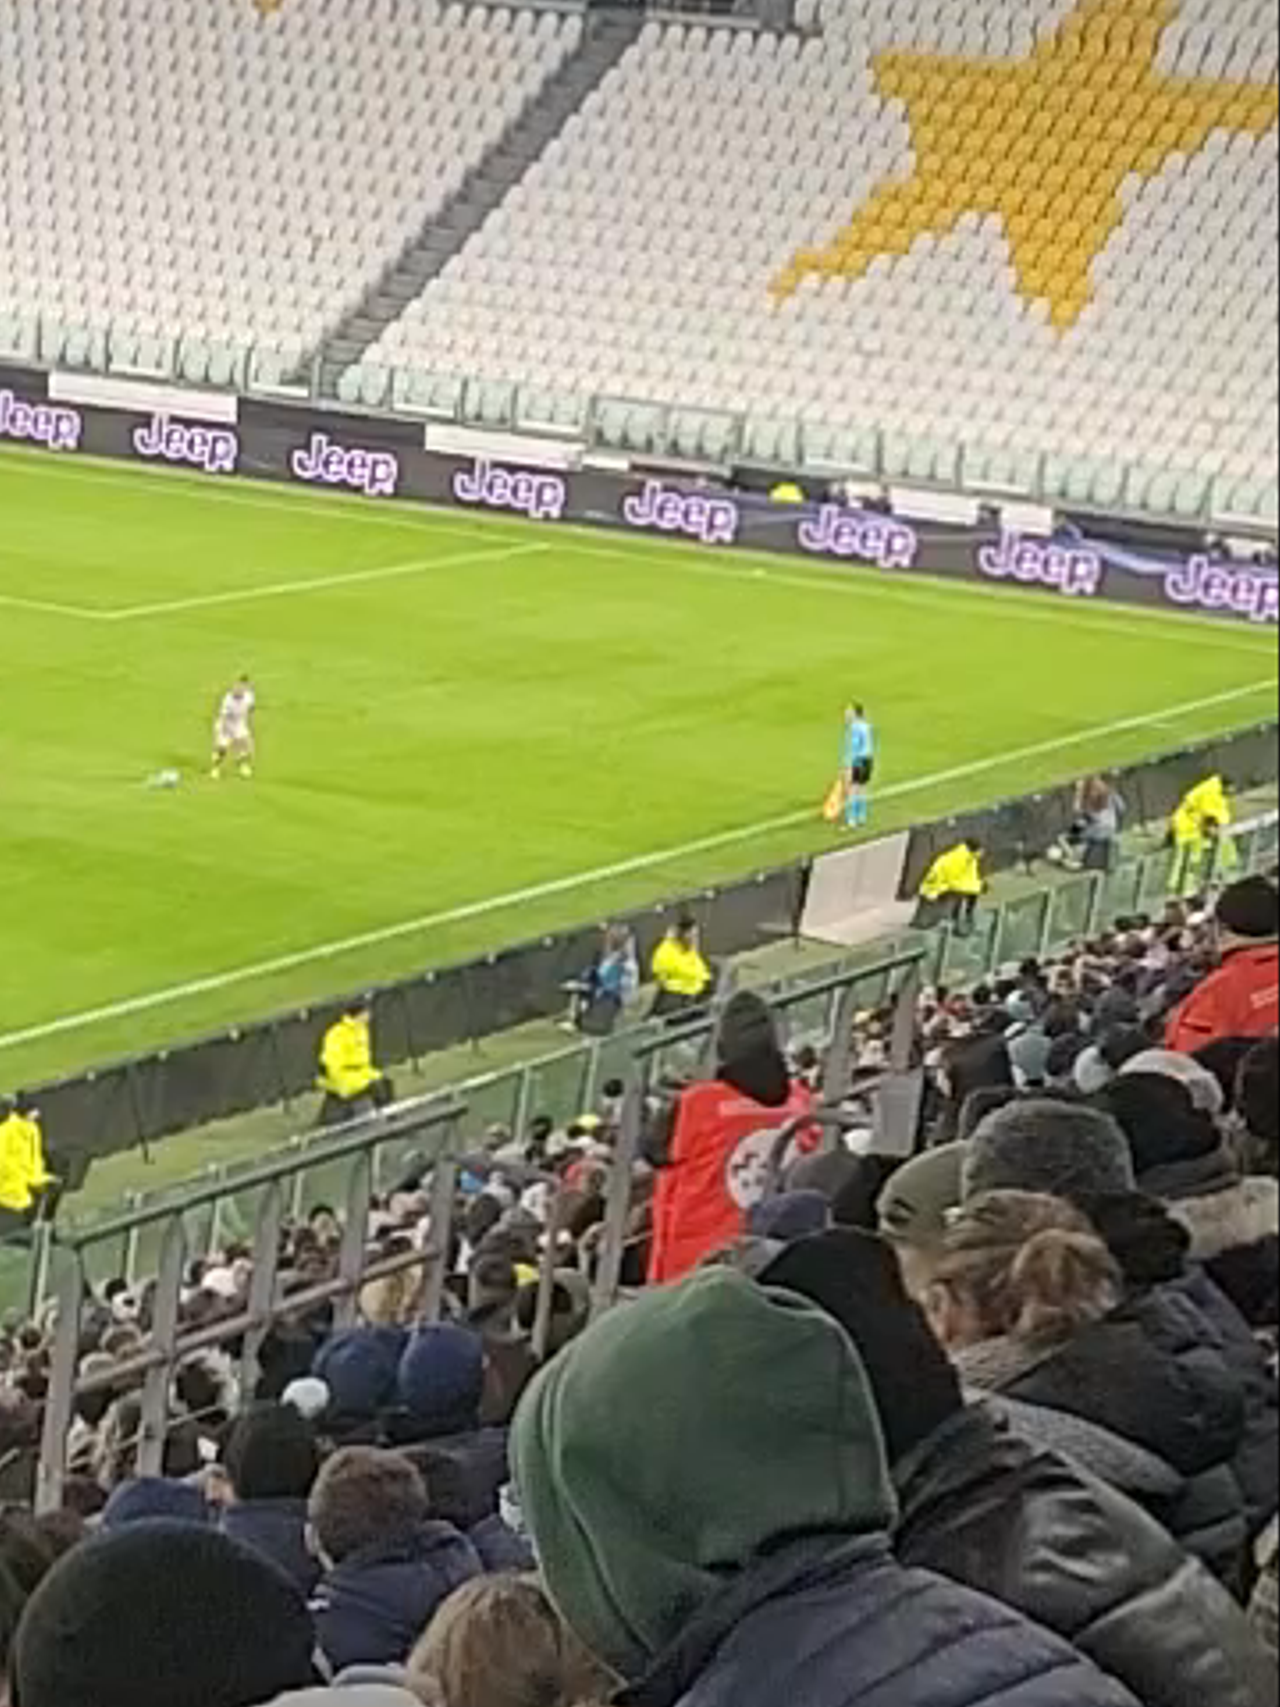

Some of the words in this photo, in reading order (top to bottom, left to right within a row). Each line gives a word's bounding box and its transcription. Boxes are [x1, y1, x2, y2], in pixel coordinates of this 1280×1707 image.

[134, 412, 237, 473] Jeep
[293, 434, 397, 494] Jeep
[454, 459, 564, 519] Jeep
[624, 480, 738, 543] Jeep
[799, 503, 917, 567] Jeep
[979, 526, 1101, 594] Jeep
